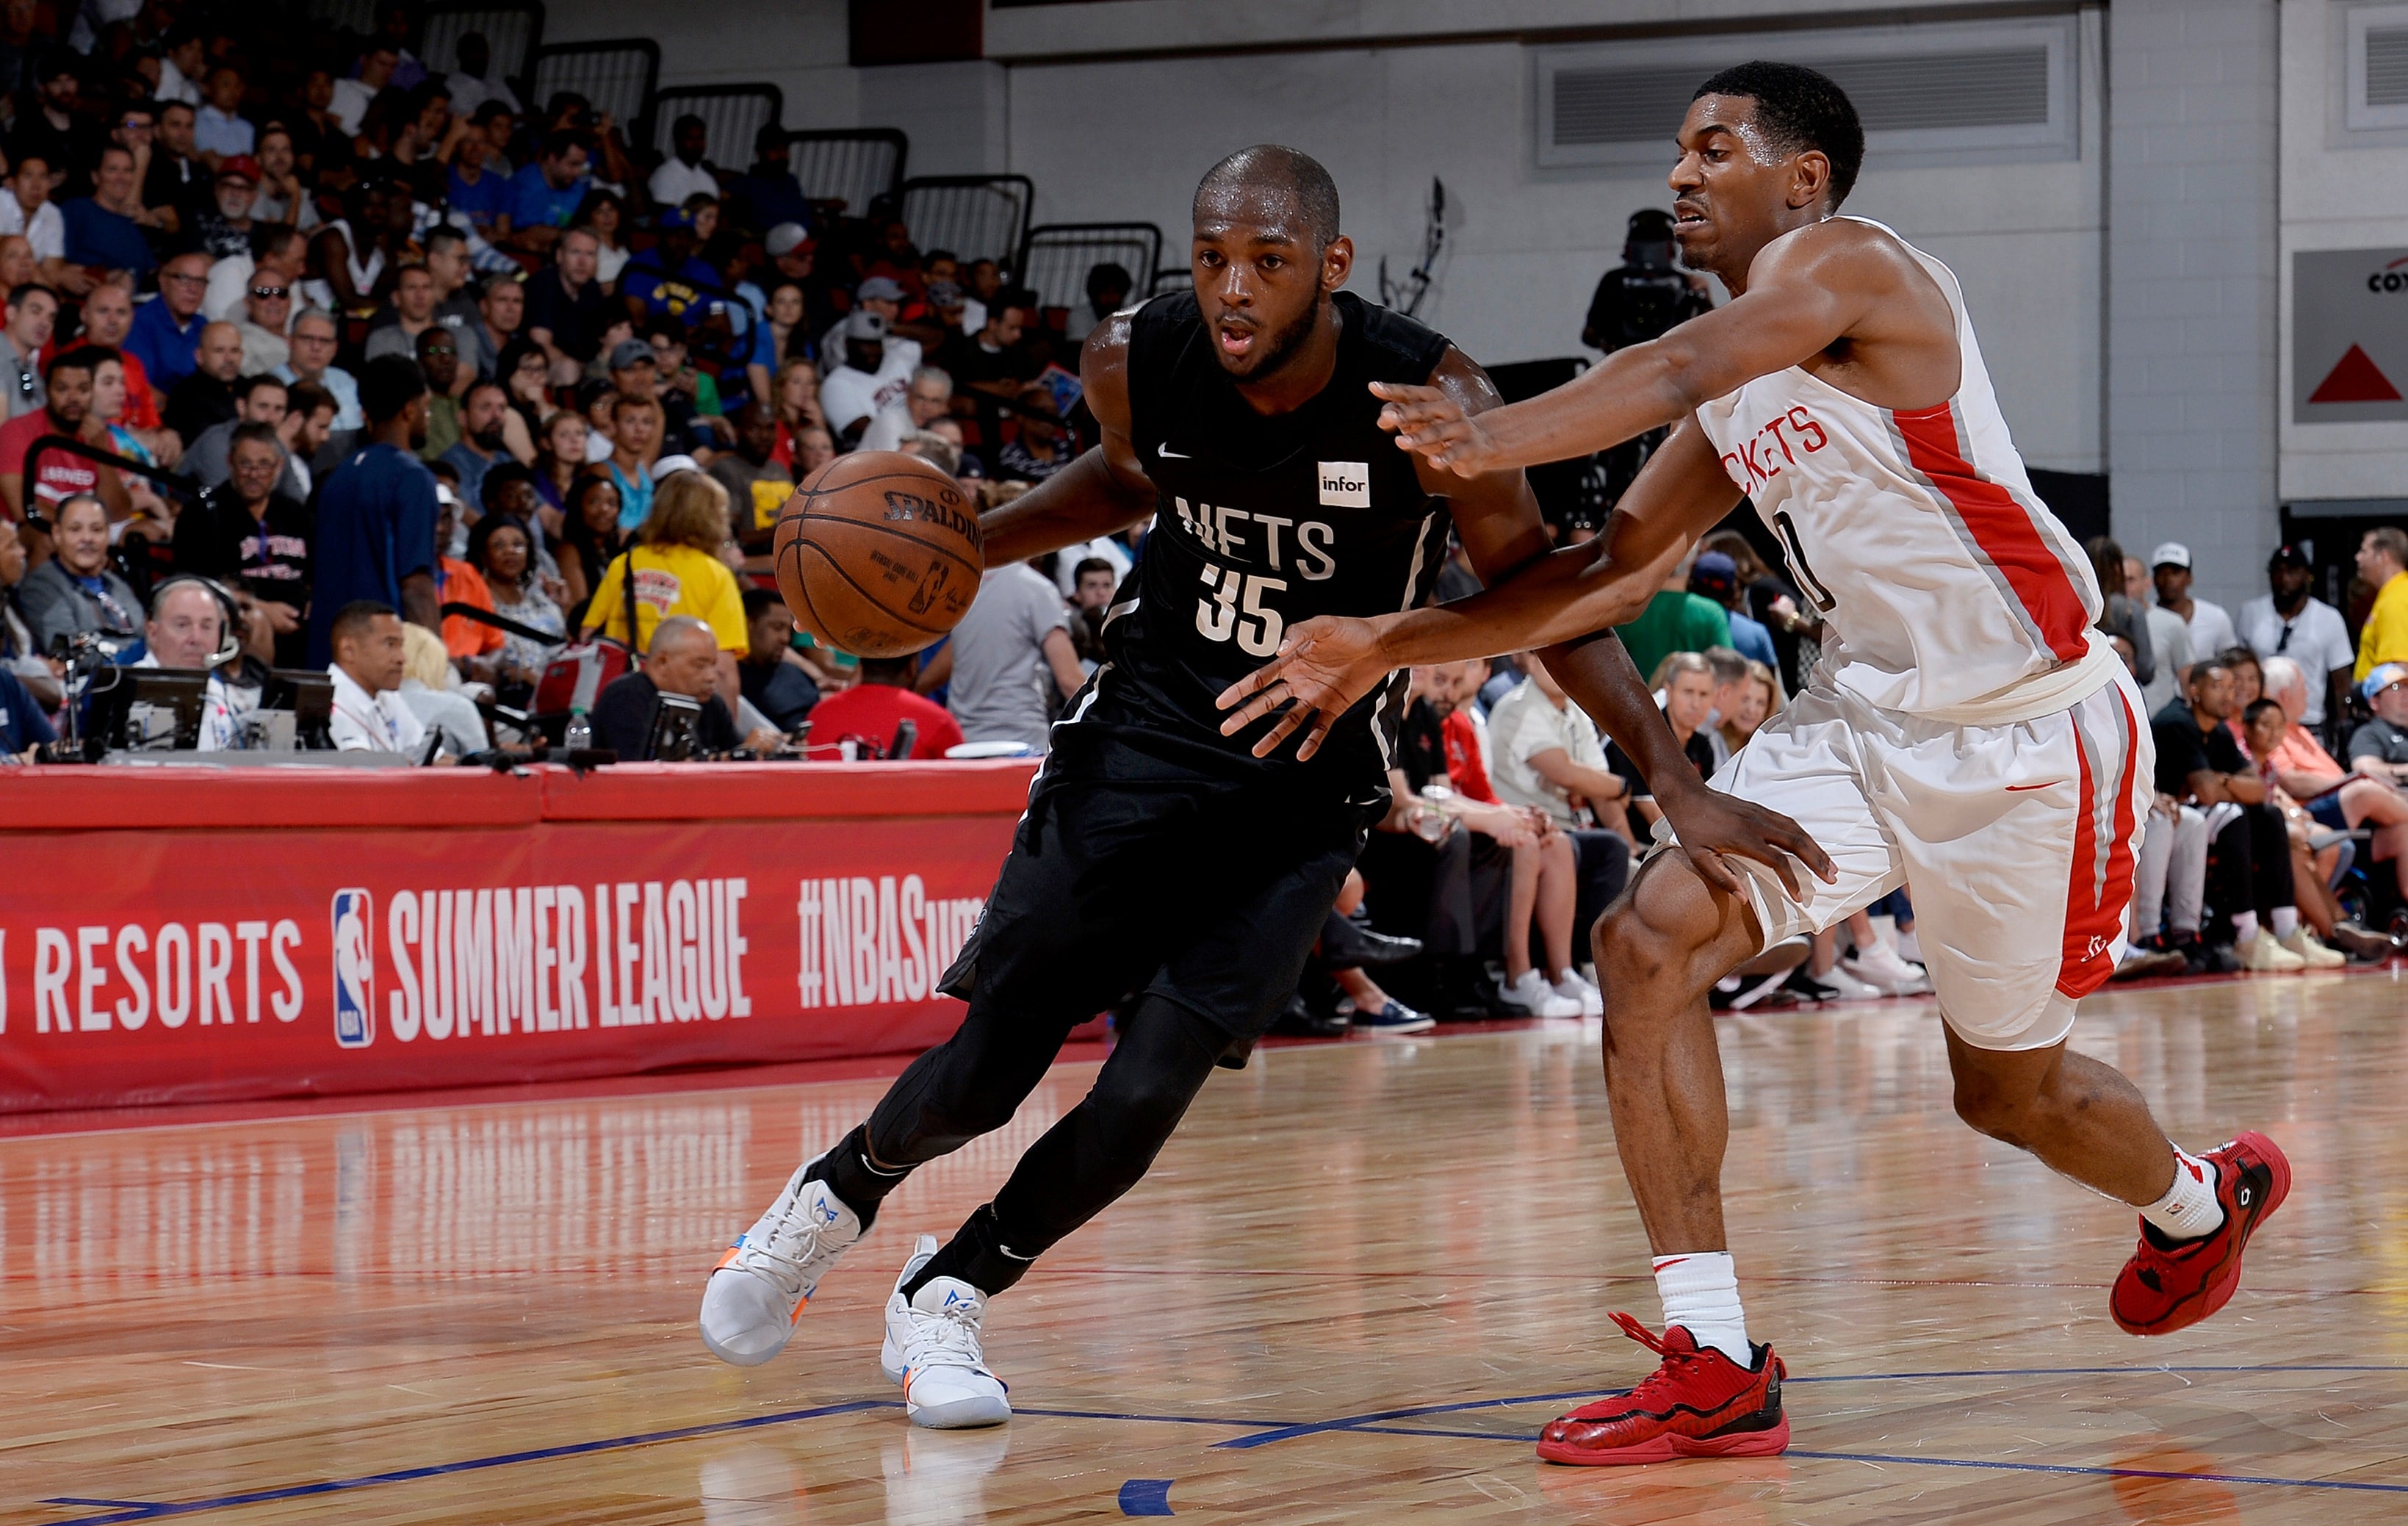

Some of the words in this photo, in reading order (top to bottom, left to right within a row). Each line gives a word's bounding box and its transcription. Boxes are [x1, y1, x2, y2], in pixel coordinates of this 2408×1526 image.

[1322, 475, 1366, 492] infor
[1175, 496, 1335, 581] NETS
[1196, 562, 1287, 657] 35
[35, 919, 304, 1033] RESORTS
[388, 885, 588, 1042] SUMMER
[595, 878, 751, 1028] LEAGUE
